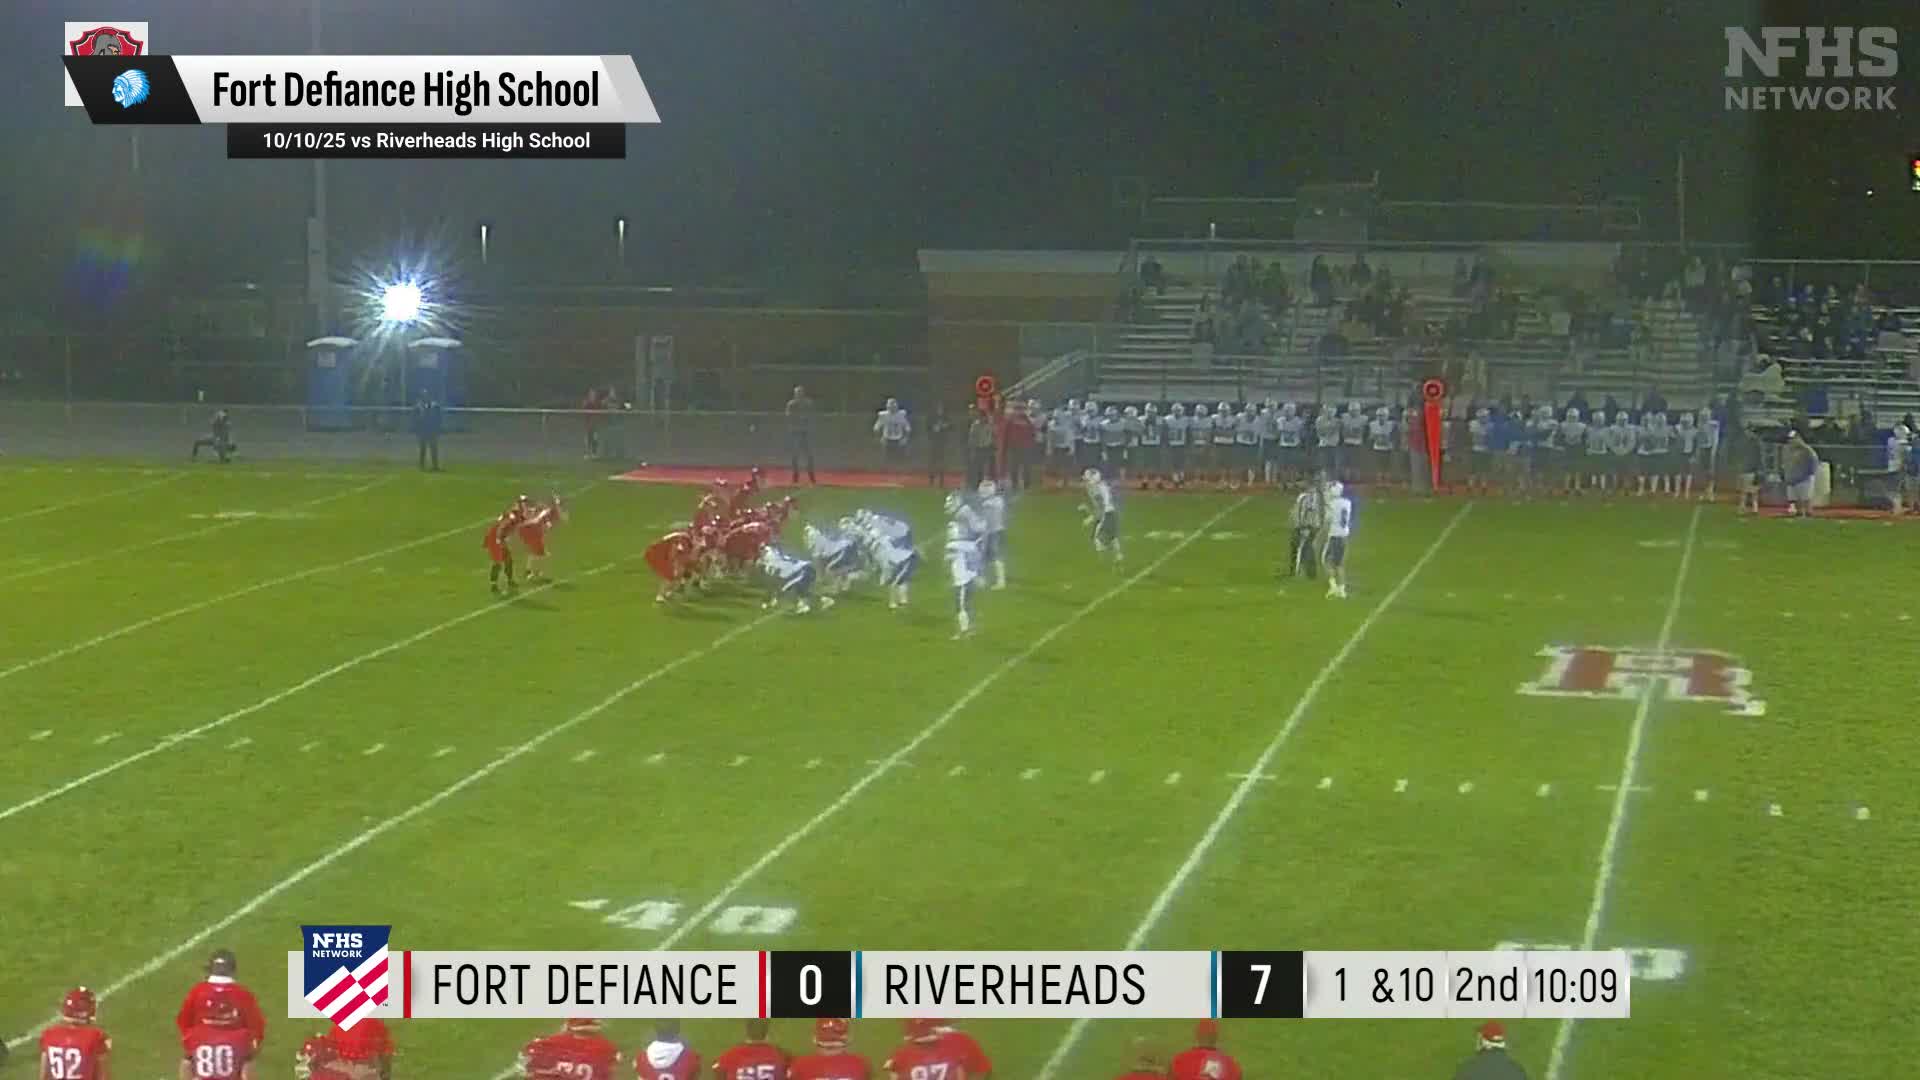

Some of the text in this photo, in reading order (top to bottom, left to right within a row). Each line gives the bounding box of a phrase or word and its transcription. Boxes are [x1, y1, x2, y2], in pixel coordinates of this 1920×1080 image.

[602, 899, 798, 935] 40
[48, 1047, 82, 1079] 52
[196, 1045, 233, 1076] 80
